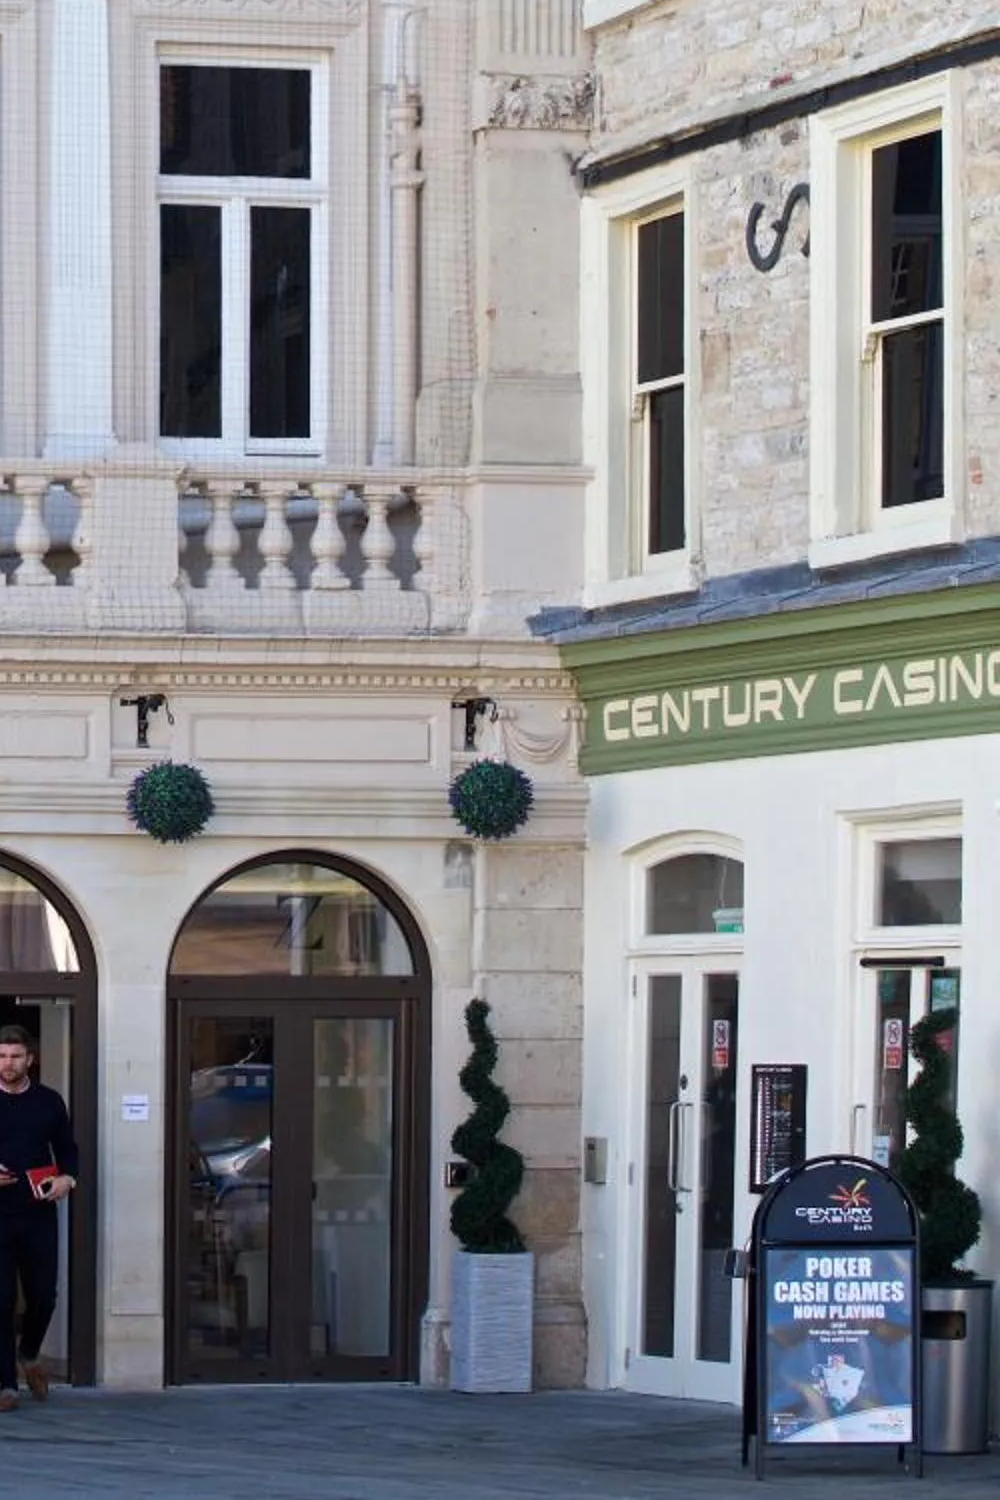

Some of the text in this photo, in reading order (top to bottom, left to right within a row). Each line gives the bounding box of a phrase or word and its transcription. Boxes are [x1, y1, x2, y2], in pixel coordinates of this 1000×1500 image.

[603, 673, 818, 742] CENTURY
[795, 1207, 873, 1216] CENTURY
[808, 1216, 873, 1224] CASINO
[805, 1257, 872, 1279] POKER
[773, 1280, 905, 1303] CASH GAMES
[793, 1304, 886, 1320] NOW PLAYING
